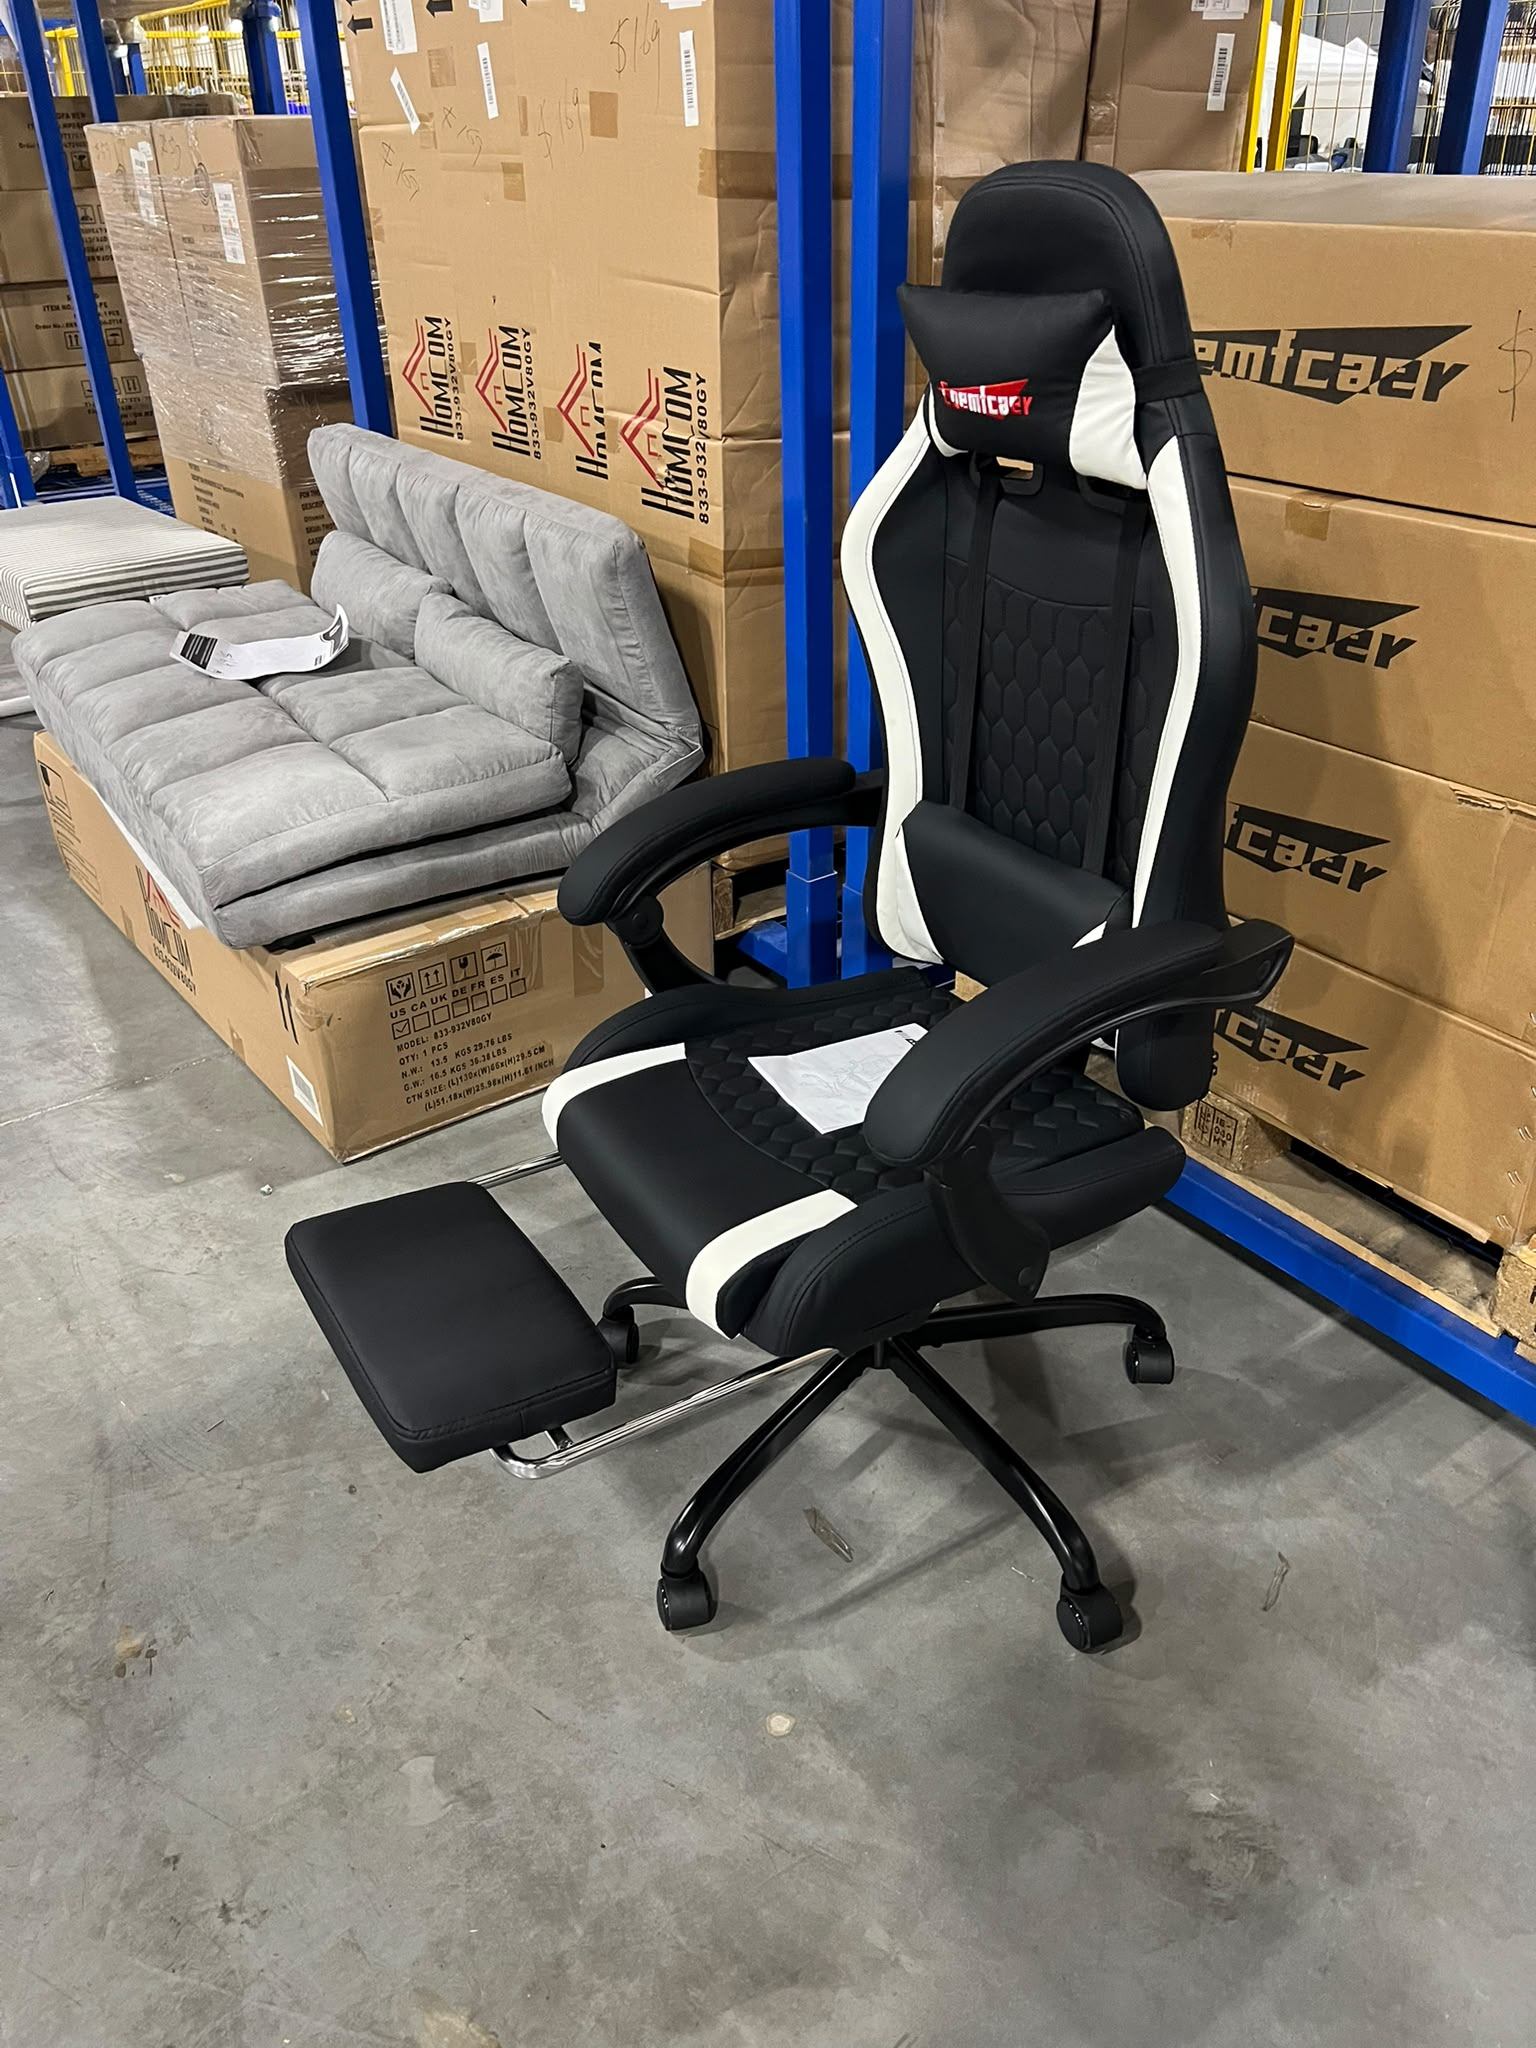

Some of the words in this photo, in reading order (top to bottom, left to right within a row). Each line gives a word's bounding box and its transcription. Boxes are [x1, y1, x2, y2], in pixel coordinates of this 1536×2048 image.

[419, 316, 455, 438] HOMCOM
[444, 317, 464, 440] 833-932V80GY
[491, 325, 531, 457] HOMCOM
[521, 327, 542, 460] 833-932V80GY
[390, 1007, 407, 1020] US
[410, 1000, 428, 1012] CA
[430, 993, 448, 1006] UK
[452, 987, 467, 998] DE
[470, 980, 486, 992] FR
[490, 974, 505, 985] ES
[510, 968, 521, 978] IT
[396, 1036, 429, 1052] MODEL:
[433, 1012, 493, 1040] 833-932V80GY
[430, 1057, 448, 1068] 13.5
[454, 1046, 472, 1059] KGS
[497, 1033, 513, 1045] LBS
[431, 1042, 449, 1054] PCS
[406, 1092, 423, 1105] CTN
[424, 1084, 447, 1097] SIZE:
[533, 1045, 546, 1056] CM
[430, 1070, 448, 1081] 16.5
[450, 1062, 467, 1074] KGS
[491, 1047, 507, 1058] LBS
[534, 1058, 555, 1071] INCH
